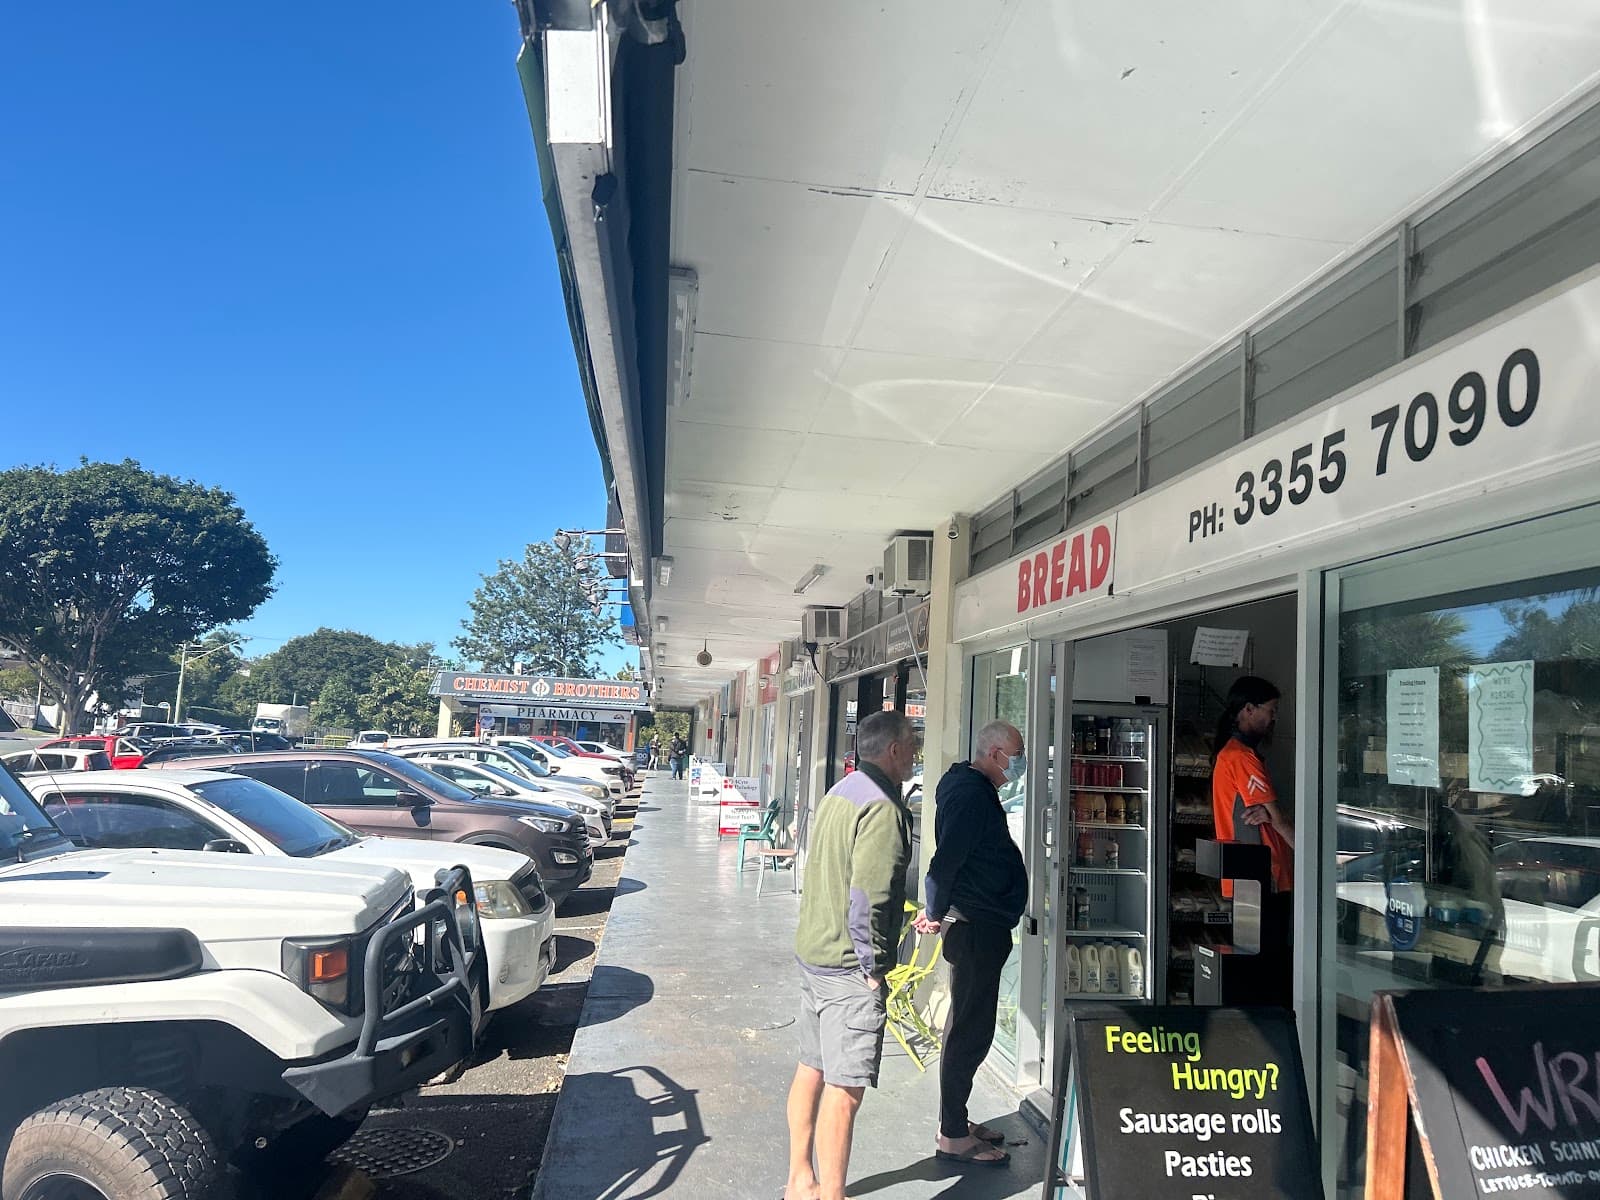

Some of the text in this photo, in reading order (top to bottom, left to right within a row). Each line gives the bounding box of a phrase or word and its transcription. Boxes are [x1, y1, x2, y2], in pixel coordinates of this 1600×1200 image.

[1188, 347, 1541, 543] PH: 3355 7090
[1017, 524, 1112, 613] BREAD
[453, 676, 641, 700] CHEMIST BROTHERS
[517, 707, 598, 721] PHARMACY
[1390, 898, 1413, 917] OPEN
[1105, 1025, 1201, 1061] Feeling
[1171, 1062, 1280, 1099] Hungry?
[1119, 1107, 1282, 1141] Sausage rolls
[1164, 1150, 1253, 1177] Pasties
[1470, 1144, 1545, 1170] CHICKEN
